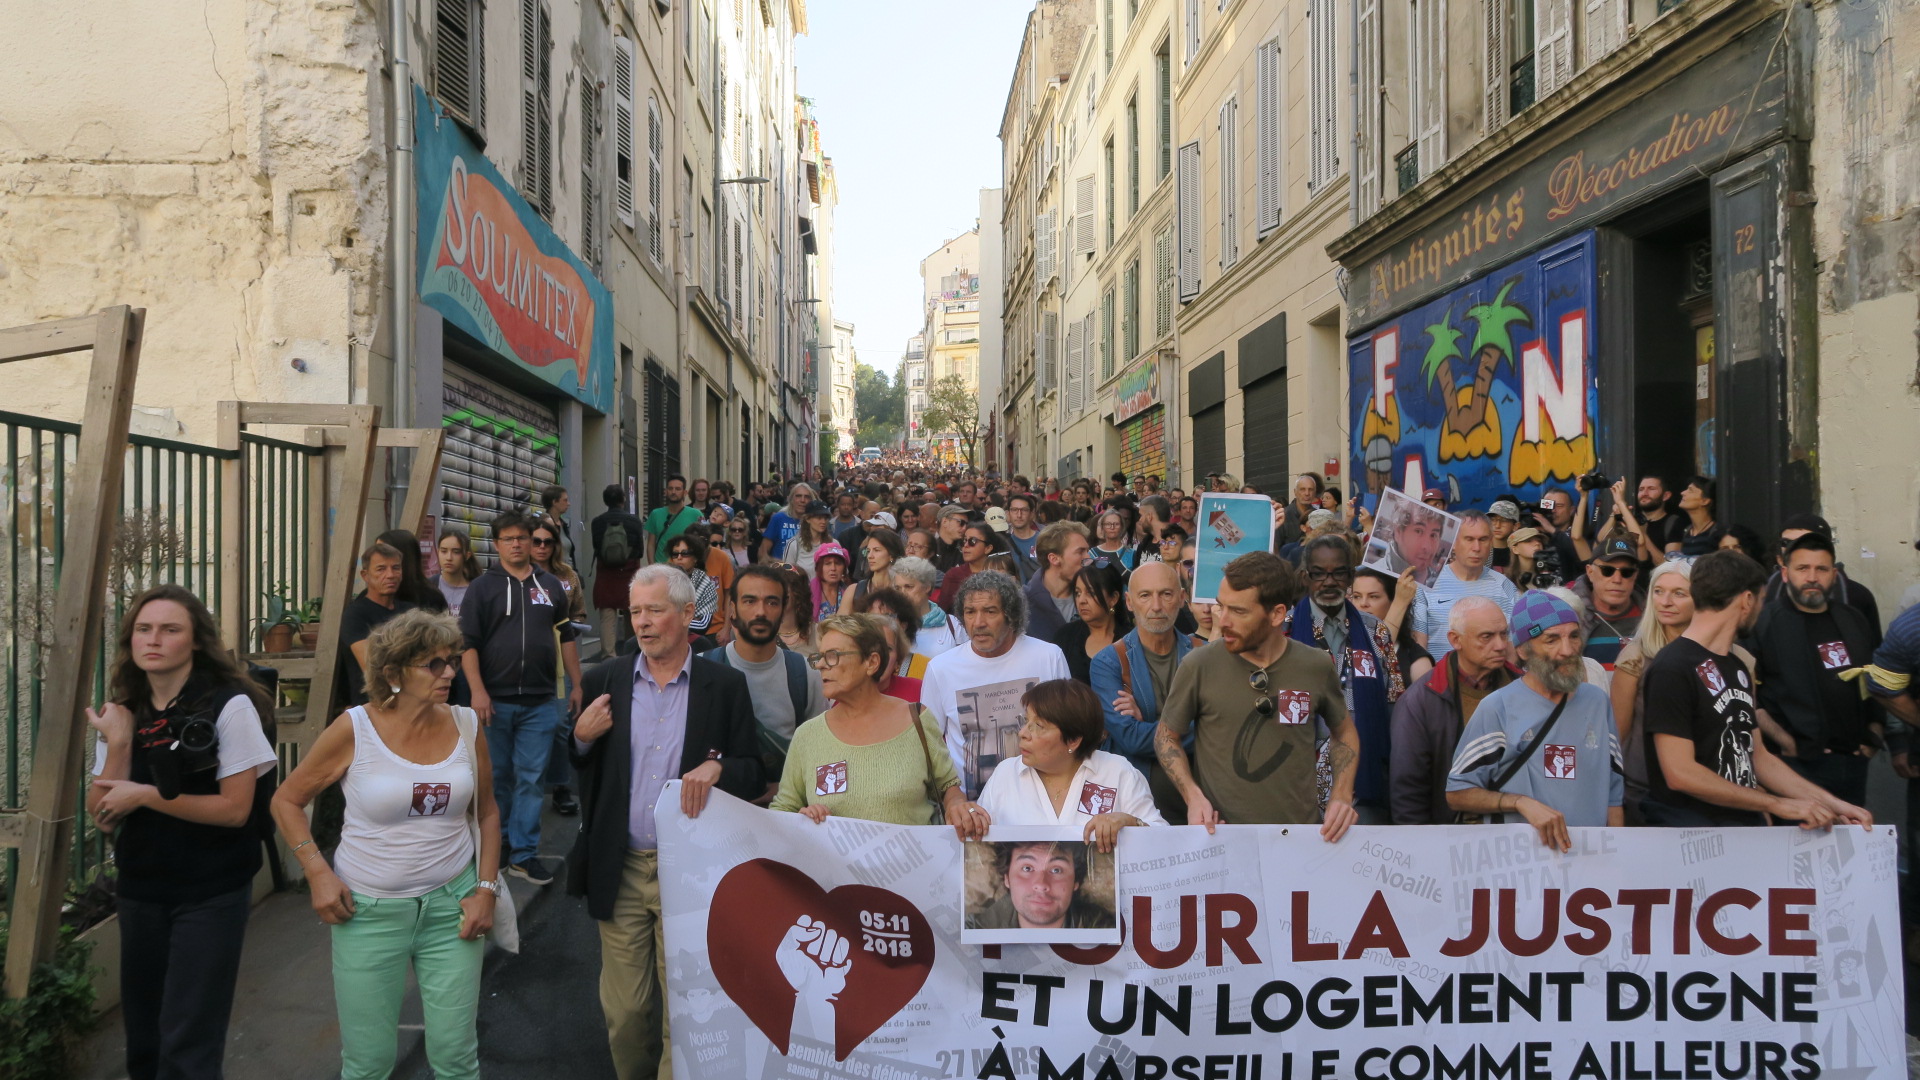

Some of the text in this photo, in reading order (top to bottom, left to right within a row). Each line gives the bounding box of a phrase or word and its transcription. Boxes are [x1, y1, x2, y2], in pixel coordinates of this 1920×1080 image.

[1374, 104, 1739, 301] Antiquités Décoration
[1735, 224, 1755, 255] 72
[448, 271, 458, 292] 06
[460, 278, 471, 302] 20
[473, 293, 482, 316] 27
[854, 829, 935, 887] MARCHE
[1119, 844, 1226, 875] ARCHE BLANCHE
[1359, 840, 1412, 870] AGORA
[1449, 829, 1618, 877] MARSELE
[1681, 834, 1725, 866] FÉVRIER
[1128, 882, 1171, 895] mémoire
[1174, 877, 1191, 888] des
[1192, 868, 1230, 884] victimes
[1352, 859, 1373, 878] de
[1291, 889, 1412, 962] LA
[1439, 888, 1818, 957] JUSTICE
[861, 934, 912, 957] 2018
[1334, 937, 1407, 972] noembre
[1153, 976, 1174, 987] RDV
[1177, 970, 1207, 983] Métro
[1208, 965, 1235, 977] Notre
[981, 971, 1065, 1027] ET
[1087, 979, 1192, 1036] UN
[1215, 971, 1585, 1036] LOGEMENT
[1606, 971, 1818, 1023] DIGNE
[906, 1019, 915, 1027] la
[696, 1043, 728, 1063] DEBOUT
[845, 1057, 871, 1078] des
[935, 1046, 1041, 1079] 27 MRS
[977, 1025, 1017, 1080] À
[1354, 1041, 1552, 1080] COMME
[1568, 1041, 1821, 1080] AILLEURS
[787, 1062, 820, 1080] samedi
